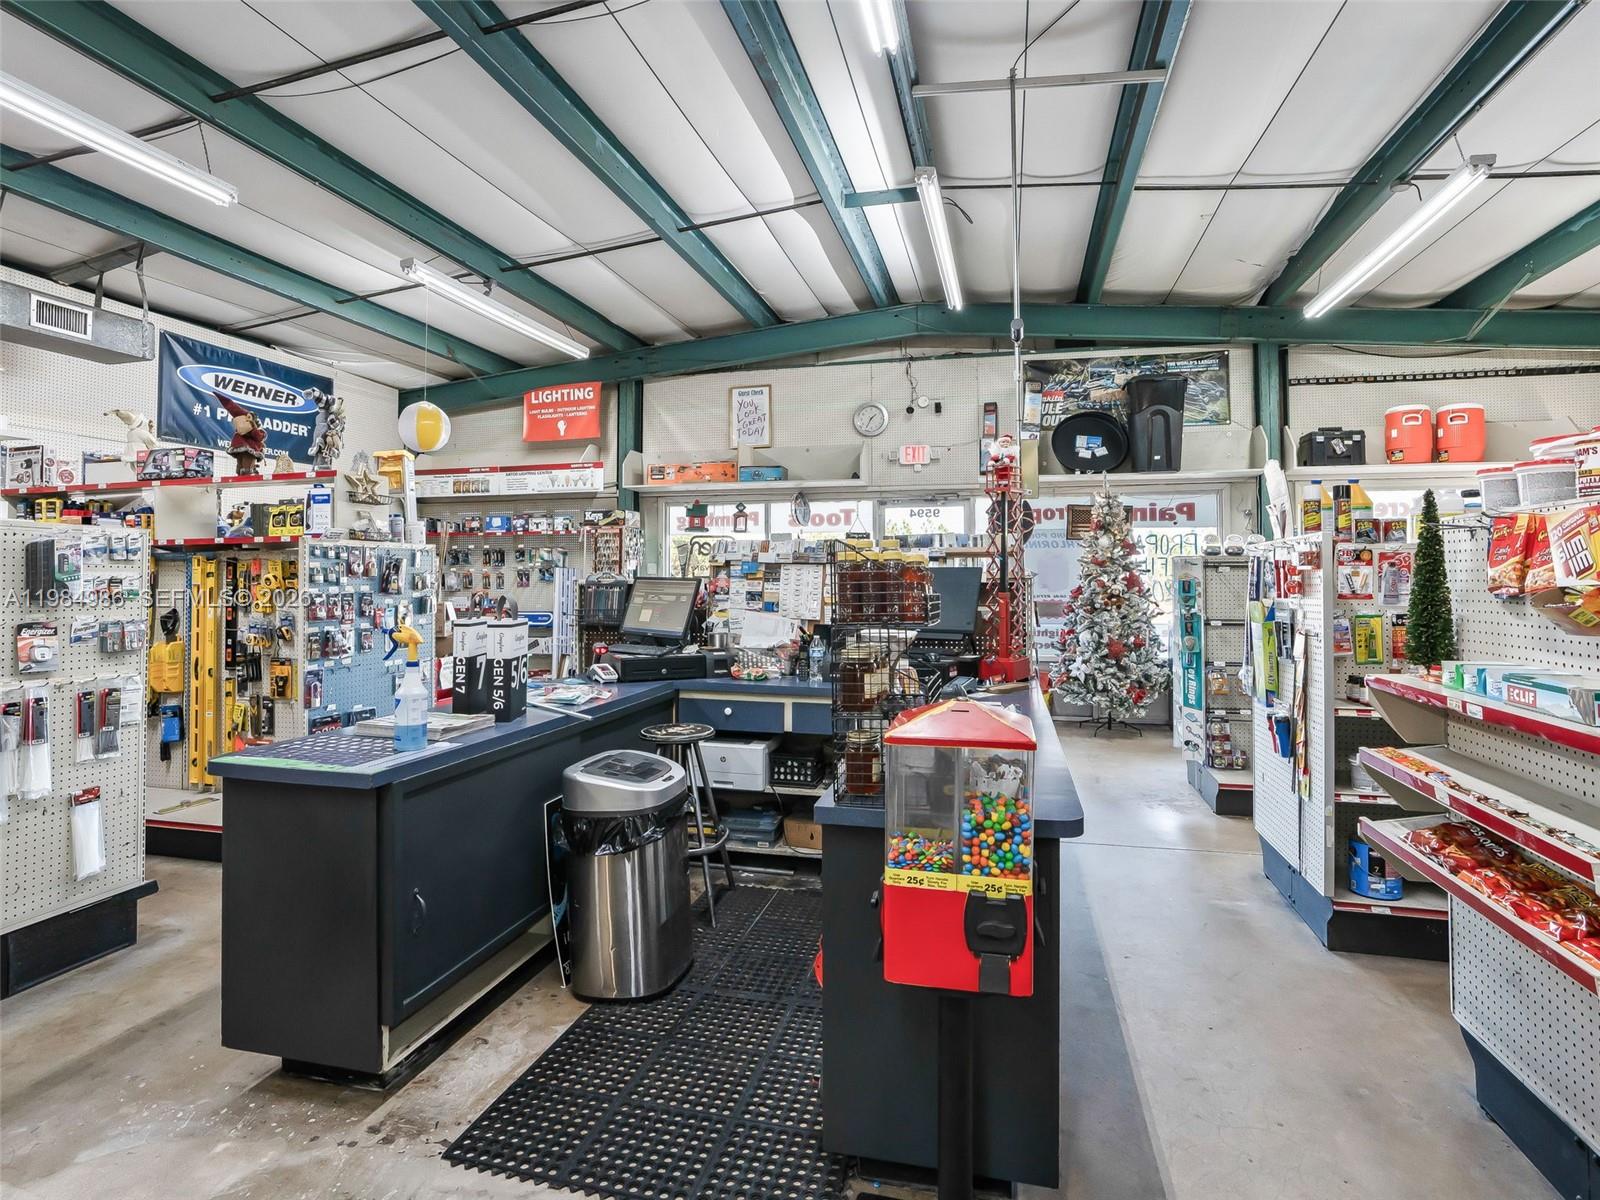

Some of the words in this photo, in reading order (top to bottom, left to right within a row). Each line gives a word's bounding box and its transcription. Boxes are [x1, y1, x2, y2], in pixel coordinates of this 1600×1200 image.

[214, 374, 298, 406] WERNER
[531, 387, 594, 404] LIGHTING
[737, 399, 754, 412] YOU
[737, 403, 759, 424] LOOK
[1042, 402, 1064, 414] ULE
[193, 403, 211, 418] #1
[257, 416, 309, 437] ADDER
[743, 413, 767, 429] GREAT
[1042, 416, 1066, 427] OUT
[904, 446, 927, 463] EXIT
[585, 511, 604, 523] Keys
[1551, 527, 1563, 541] 20
[20, 627, 56, 636] Energizer
[73, 624, 97, 633] Energizer
[455, 657, 466, 683] GEN
[476, 655, 487, 690] 7
[493, 659, 504, 686] GEN
[511, 655, 527, 690] 5/6
[455, 685, 466, 694] 7
[1187, 680, 1197, 705] Rings
[1513, 688, 1535, 705] CLIF
[492, 689, 505, 710] 5/6
[907, 876, 925, 886] 25¢
[984, 883, 1003, 893] 25¢
